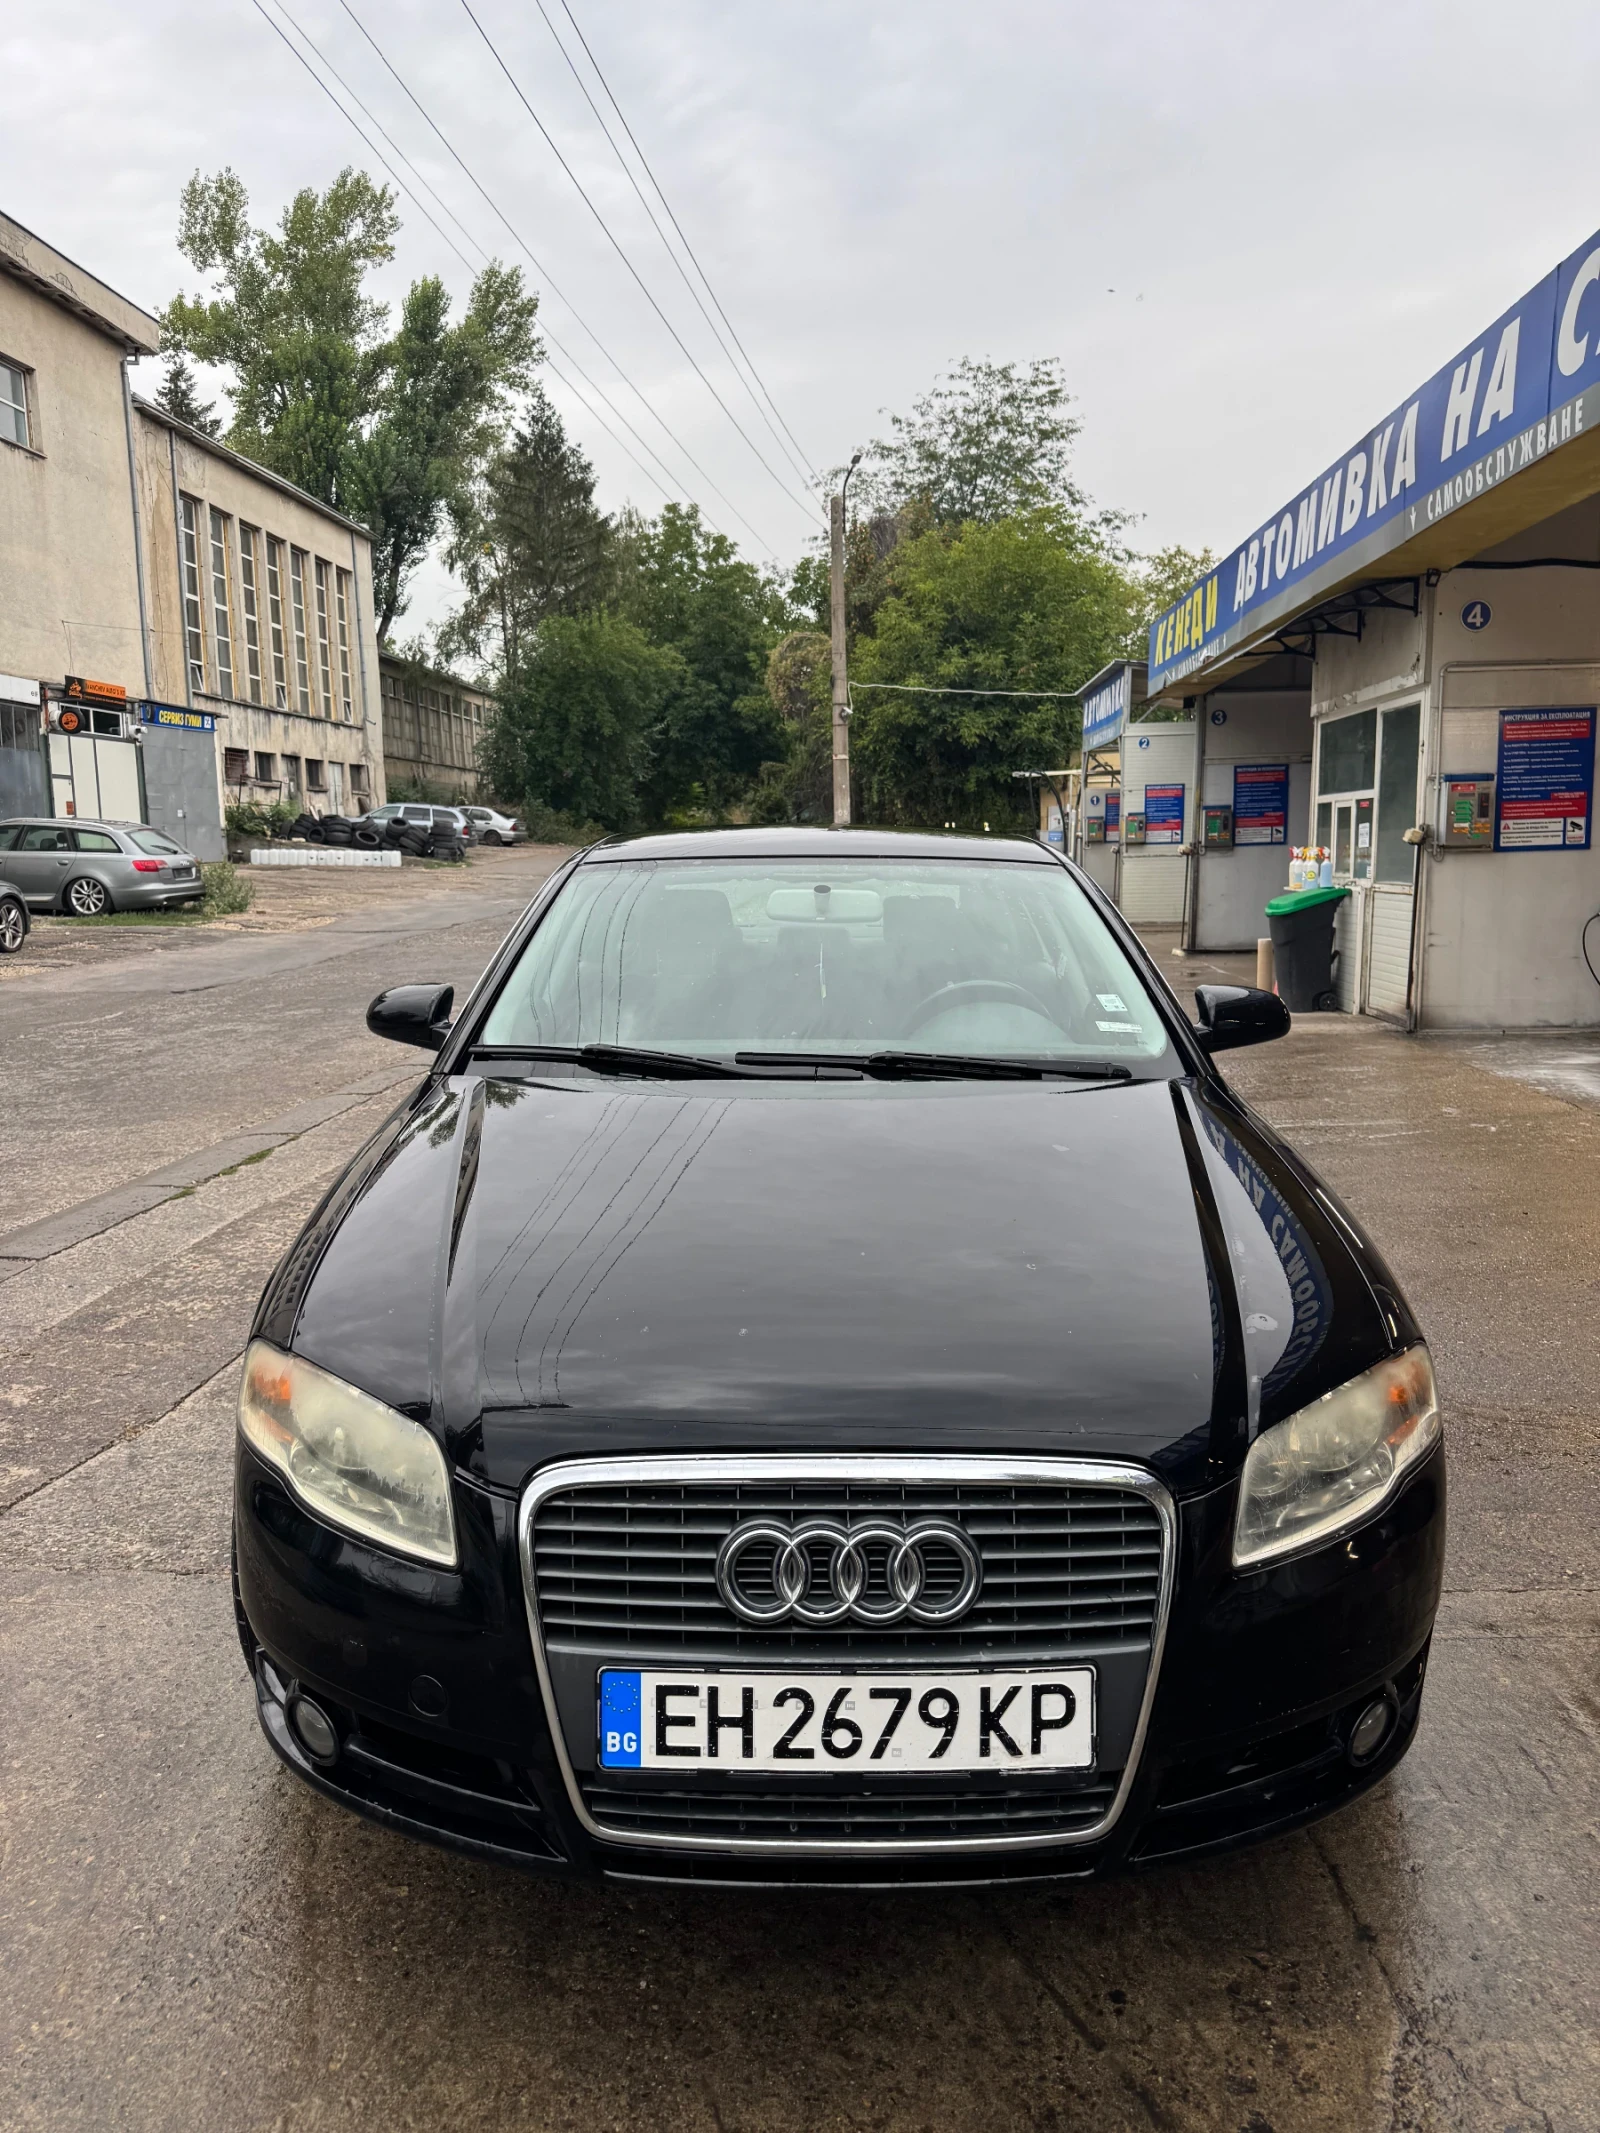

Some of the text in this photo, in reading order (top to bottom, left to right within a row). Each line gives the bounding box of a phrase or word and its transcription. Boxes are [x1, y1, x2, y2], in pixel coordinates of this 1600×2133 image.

[1155, 246, 1600, 668] КЕНЕДИ АВТОМИВКА НА С
[1427, 397, 1583, 521] САМООБСЛУЖВАНЕ
[1467, 604, 1483, 626] 4
[159, 710, 202, 728] СЕРВИЗ ГУМИ
[1215, 712, 1223, 724] 3
[1141, 738, 1148, 748] 2
[606, 1732, 637, 1753] BG
